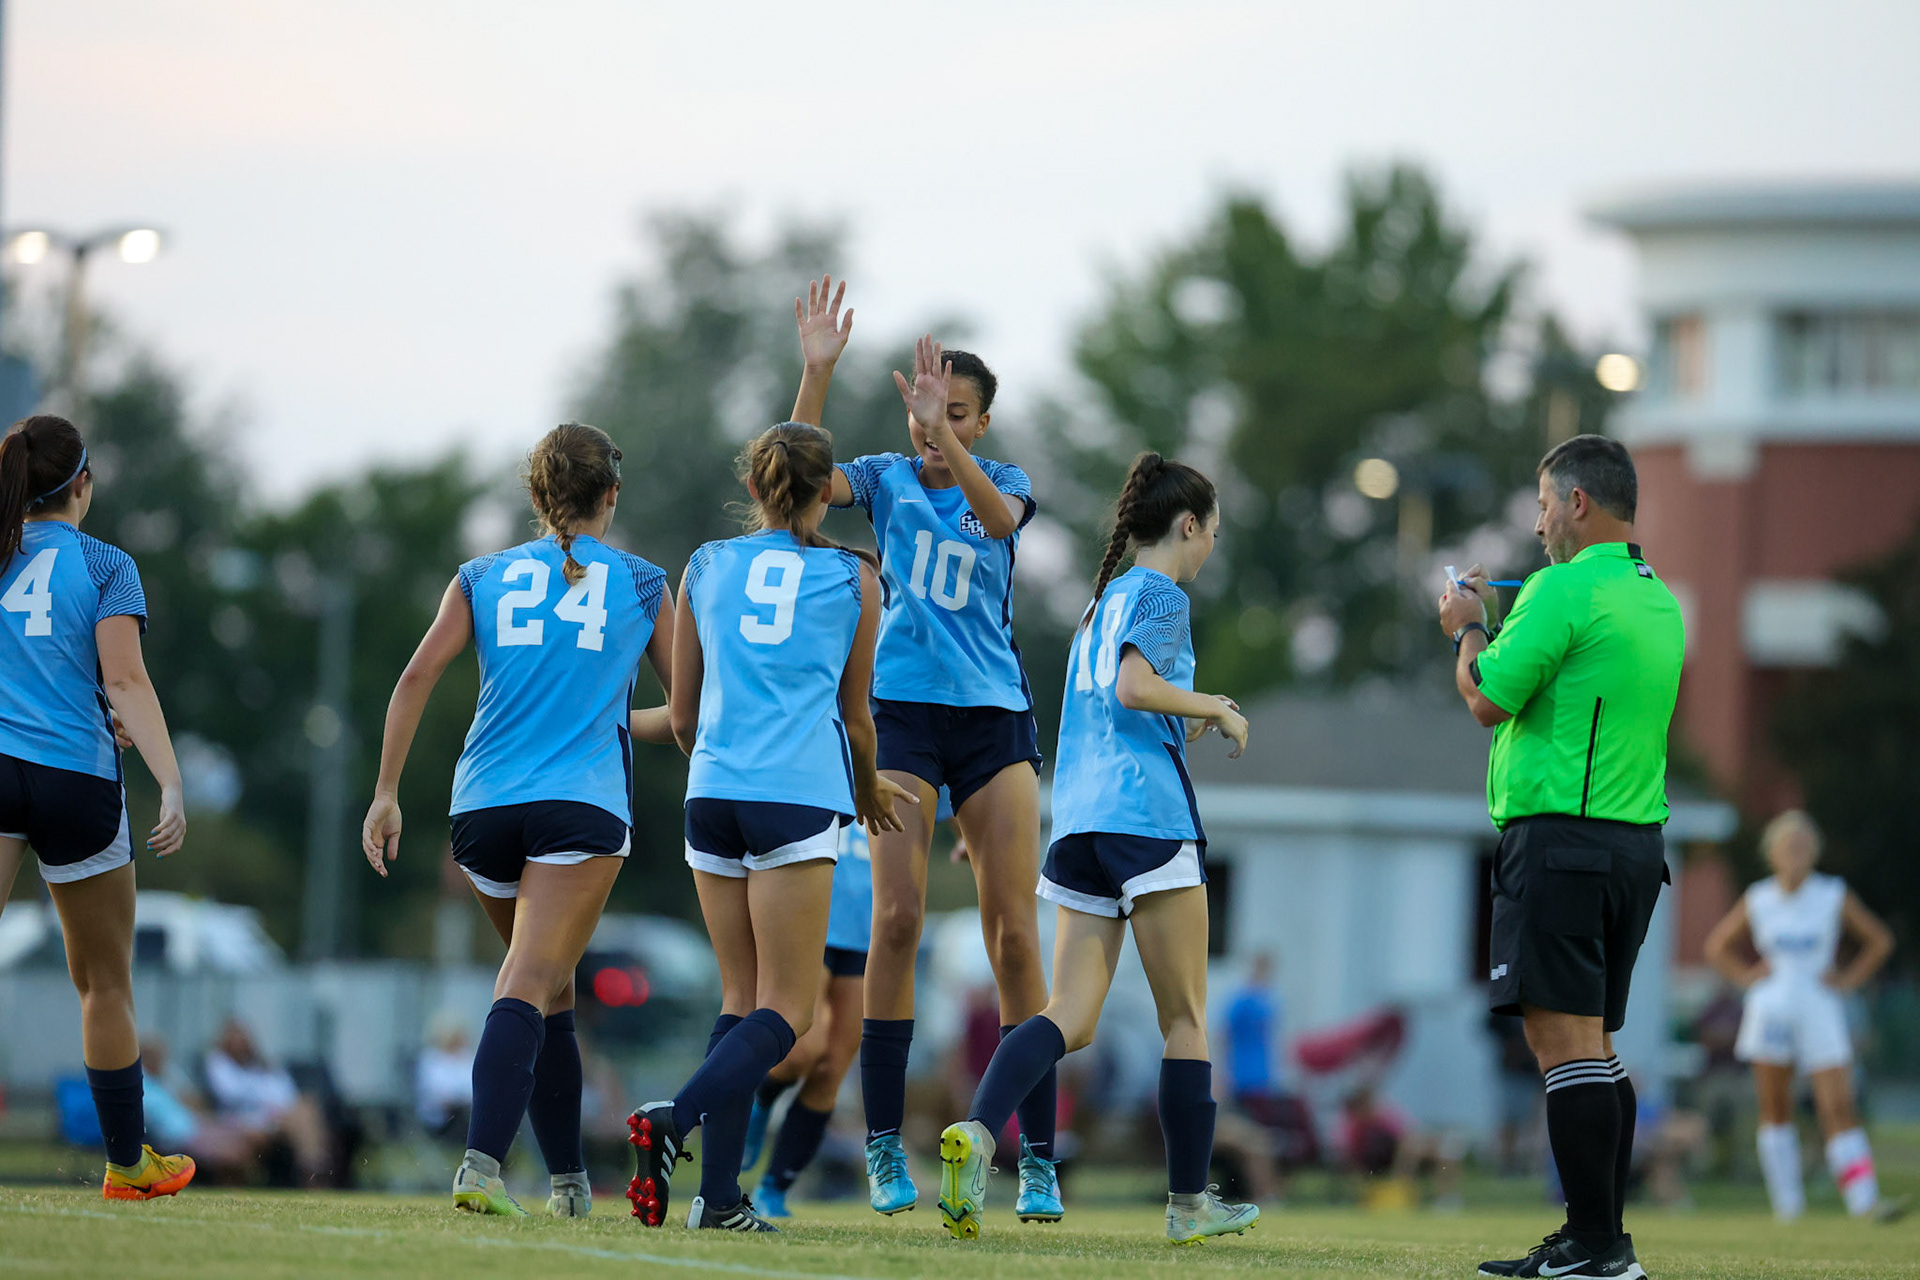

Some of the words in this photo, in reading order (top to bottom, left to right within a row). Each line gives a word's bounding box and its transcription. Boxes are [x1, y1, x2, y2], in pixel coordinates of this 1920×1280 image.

[0, 548, 59, 637] 4
[496, 559, 609, 652] 24
[739, 549, 805, 645] 9
[908, 530, 977, 611] 10
[1076, 593, 1128, 692] 18
